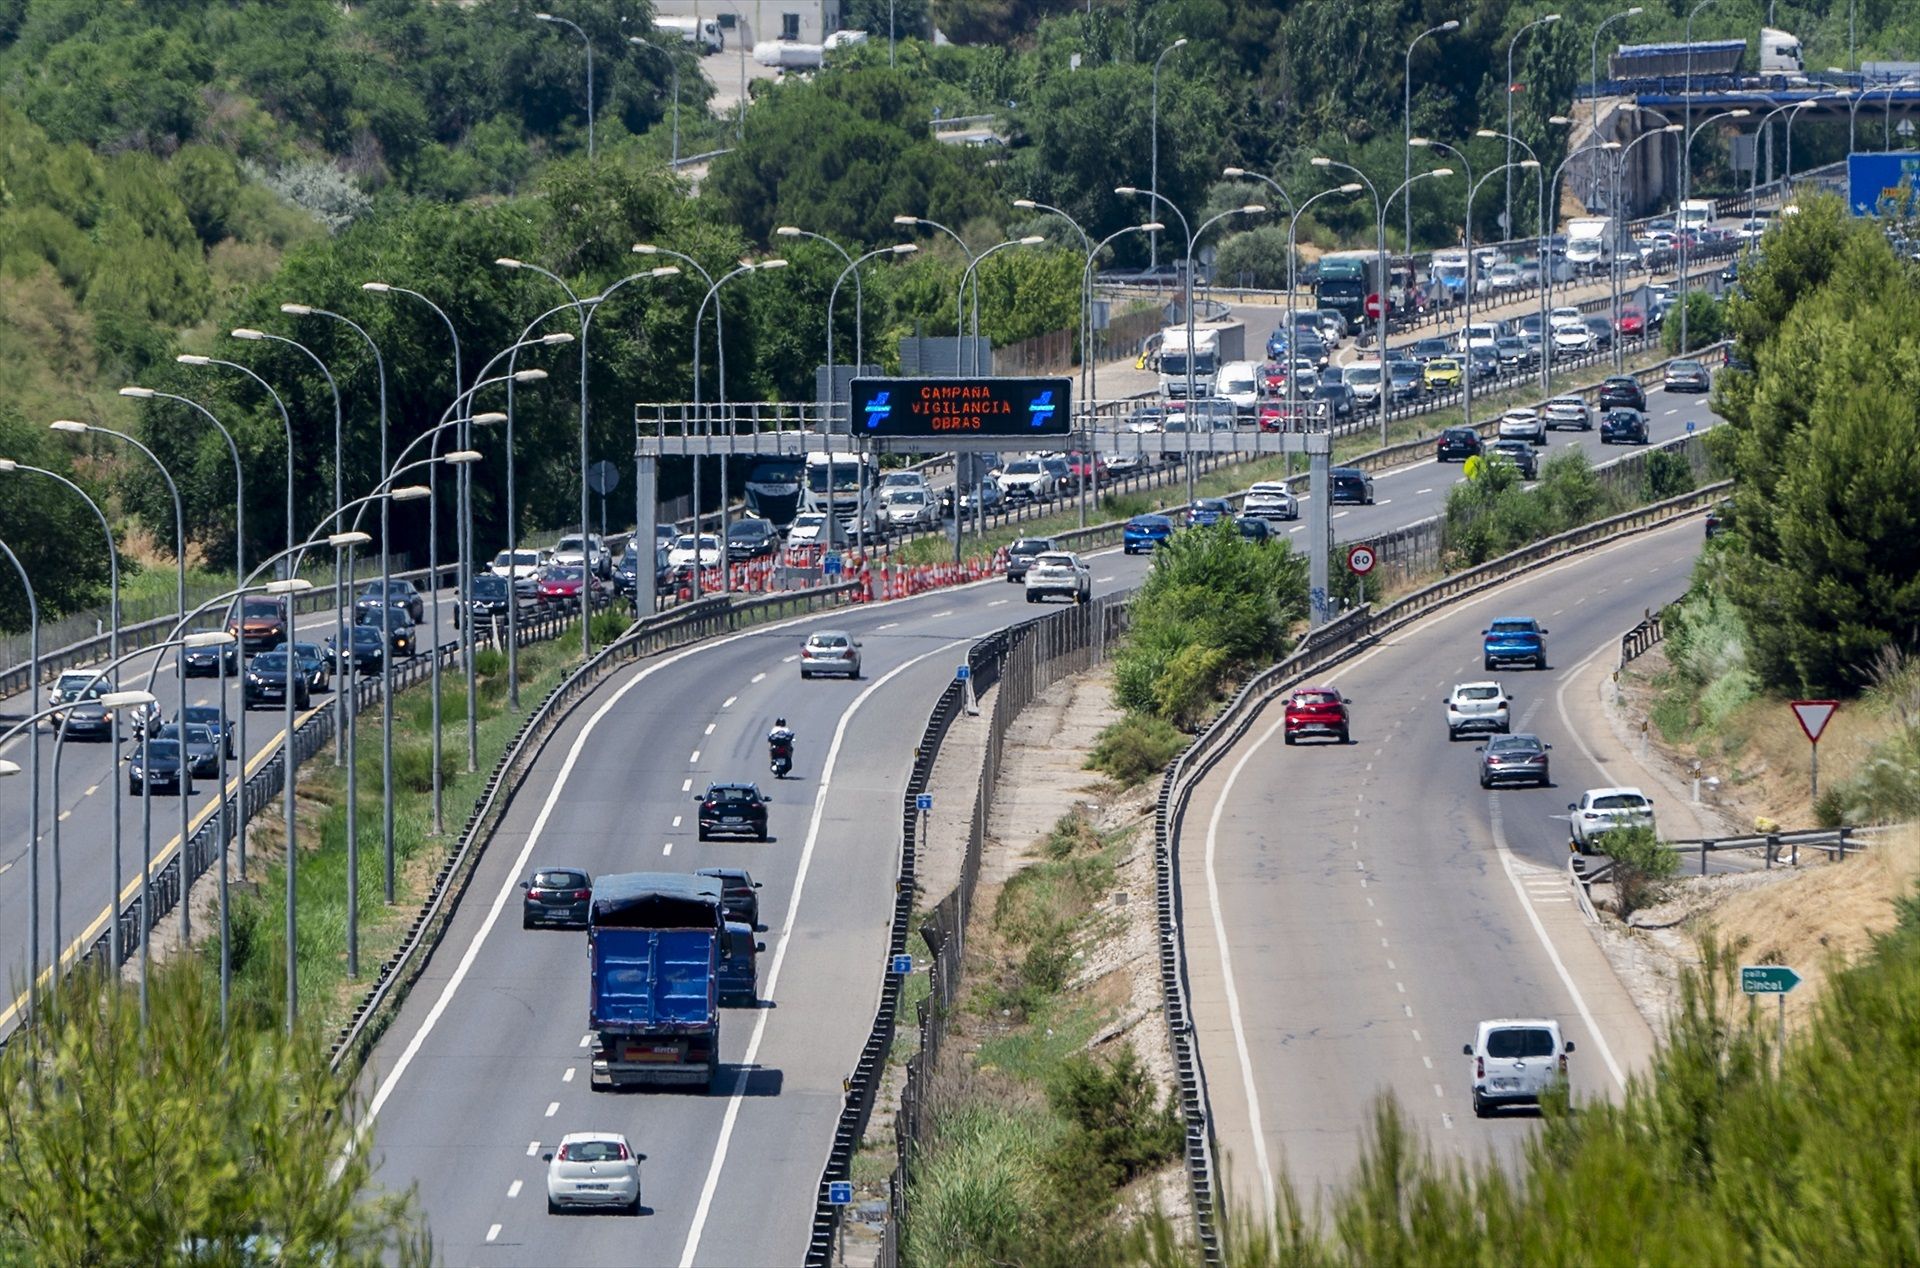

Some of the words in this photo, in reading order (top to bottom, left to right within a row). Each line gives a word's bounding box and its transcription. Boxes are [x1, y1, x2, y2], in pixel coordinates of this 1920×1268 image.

[921, 386, 991, 399] CAMPAÑA
[912, 401, 1011, 414] VIGILANCIA
[931, 416, 981, 429] OBRAS
[1354, 555, 1370, 565] 60
[837, 1191, 845, 1200] 4
